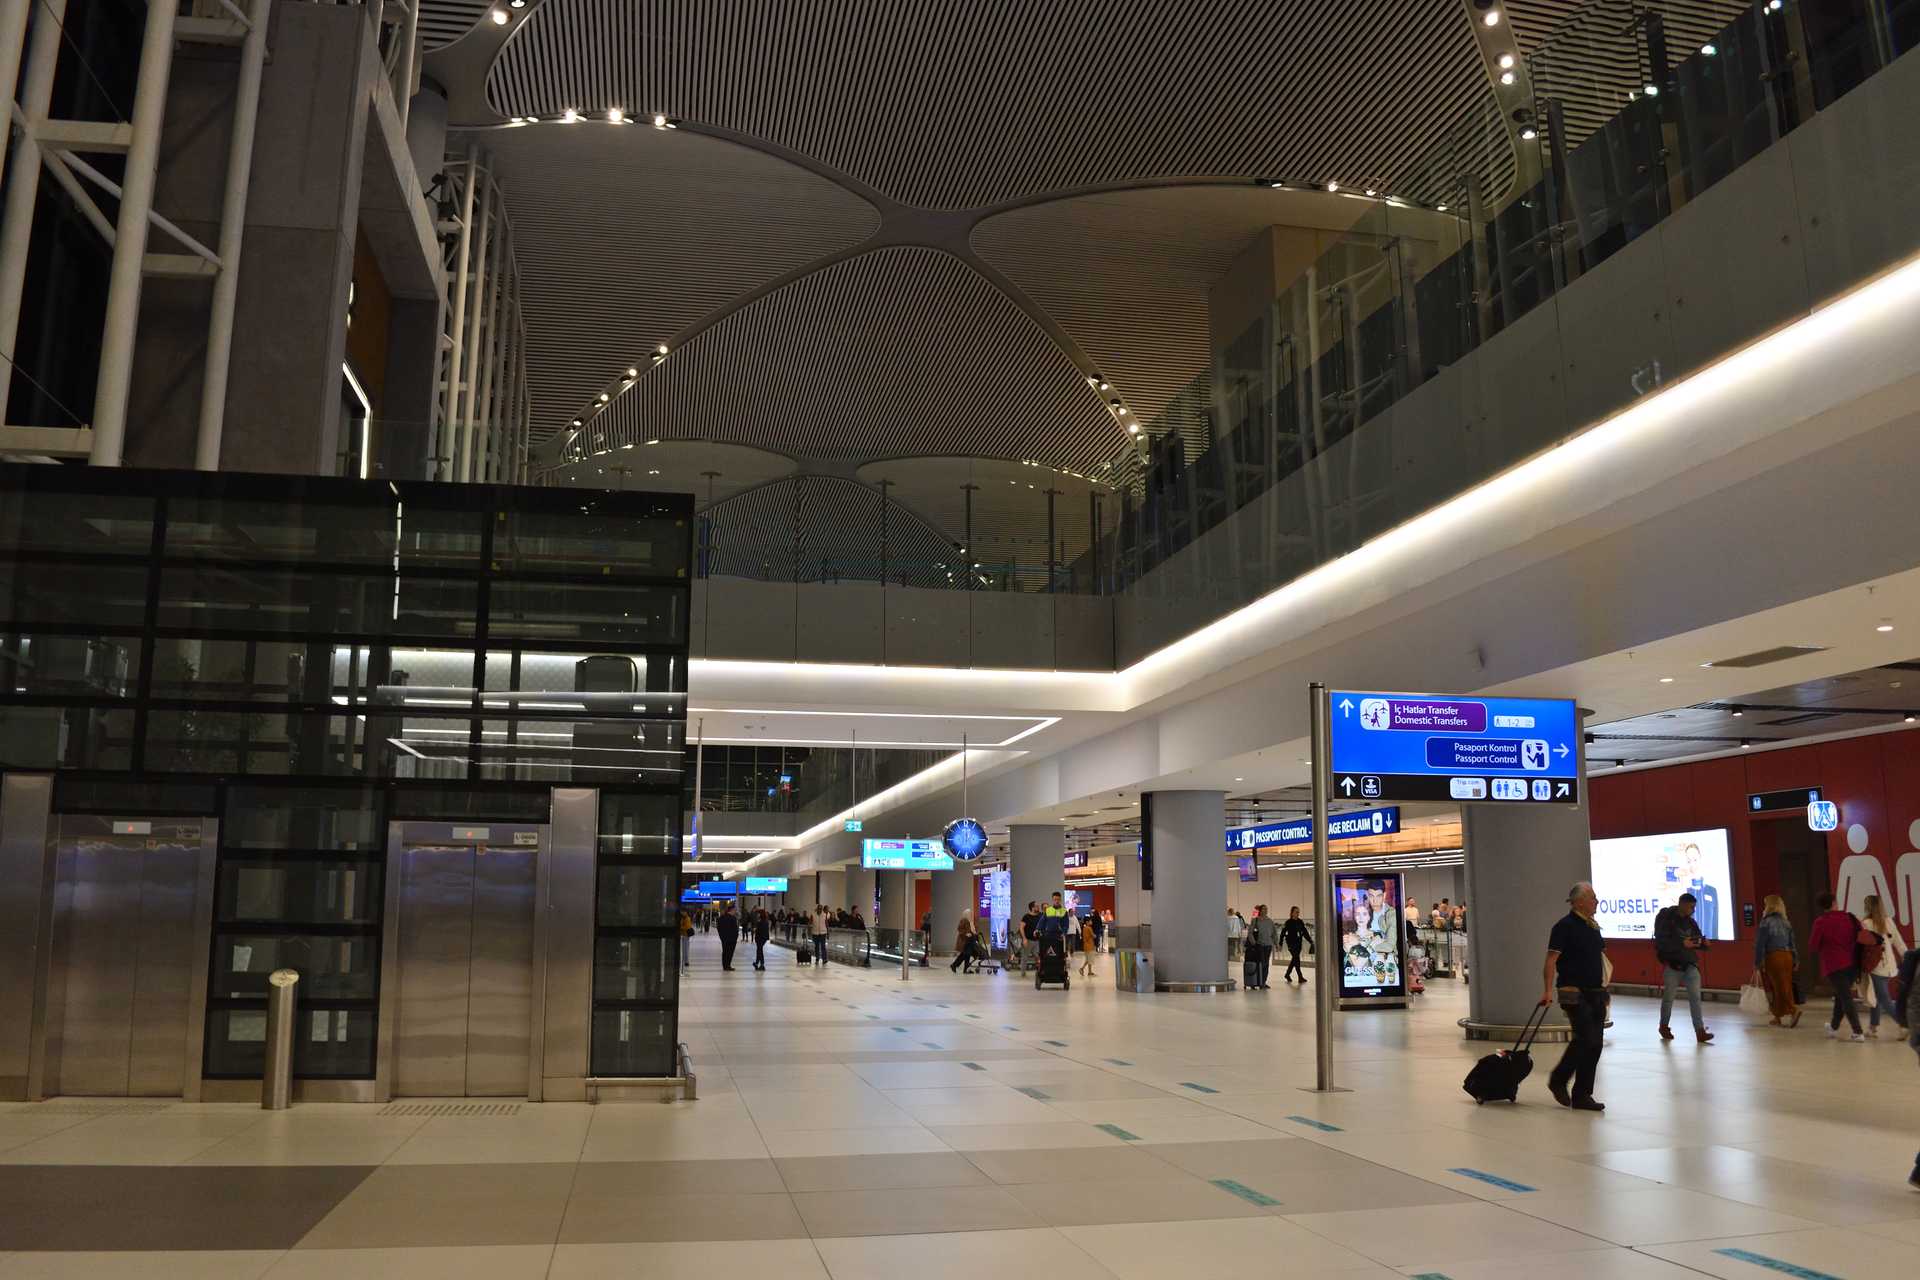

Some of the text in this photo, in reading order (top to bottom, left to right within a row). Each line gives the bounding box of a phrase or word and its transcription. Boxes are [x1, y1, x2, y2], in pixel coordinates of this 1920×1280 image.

[1403, 705, 1427, 714] Hatlar
[1427, 705, 1459, 715] Transfer
[1394, 715, 1468, 726] Domestic Transfers
[1454, 742, 1517, 753] Pasaport Kontrol
[1455, 753, 1518, 764] Passport Control
[1255, 828, 1282, 843] PASSPORT
[1282, 826, 1309, 840] CONTROL
[1341, 818, 1371, 833] RECLAIM
[1599, 899, 1659, 914] OURSELF
